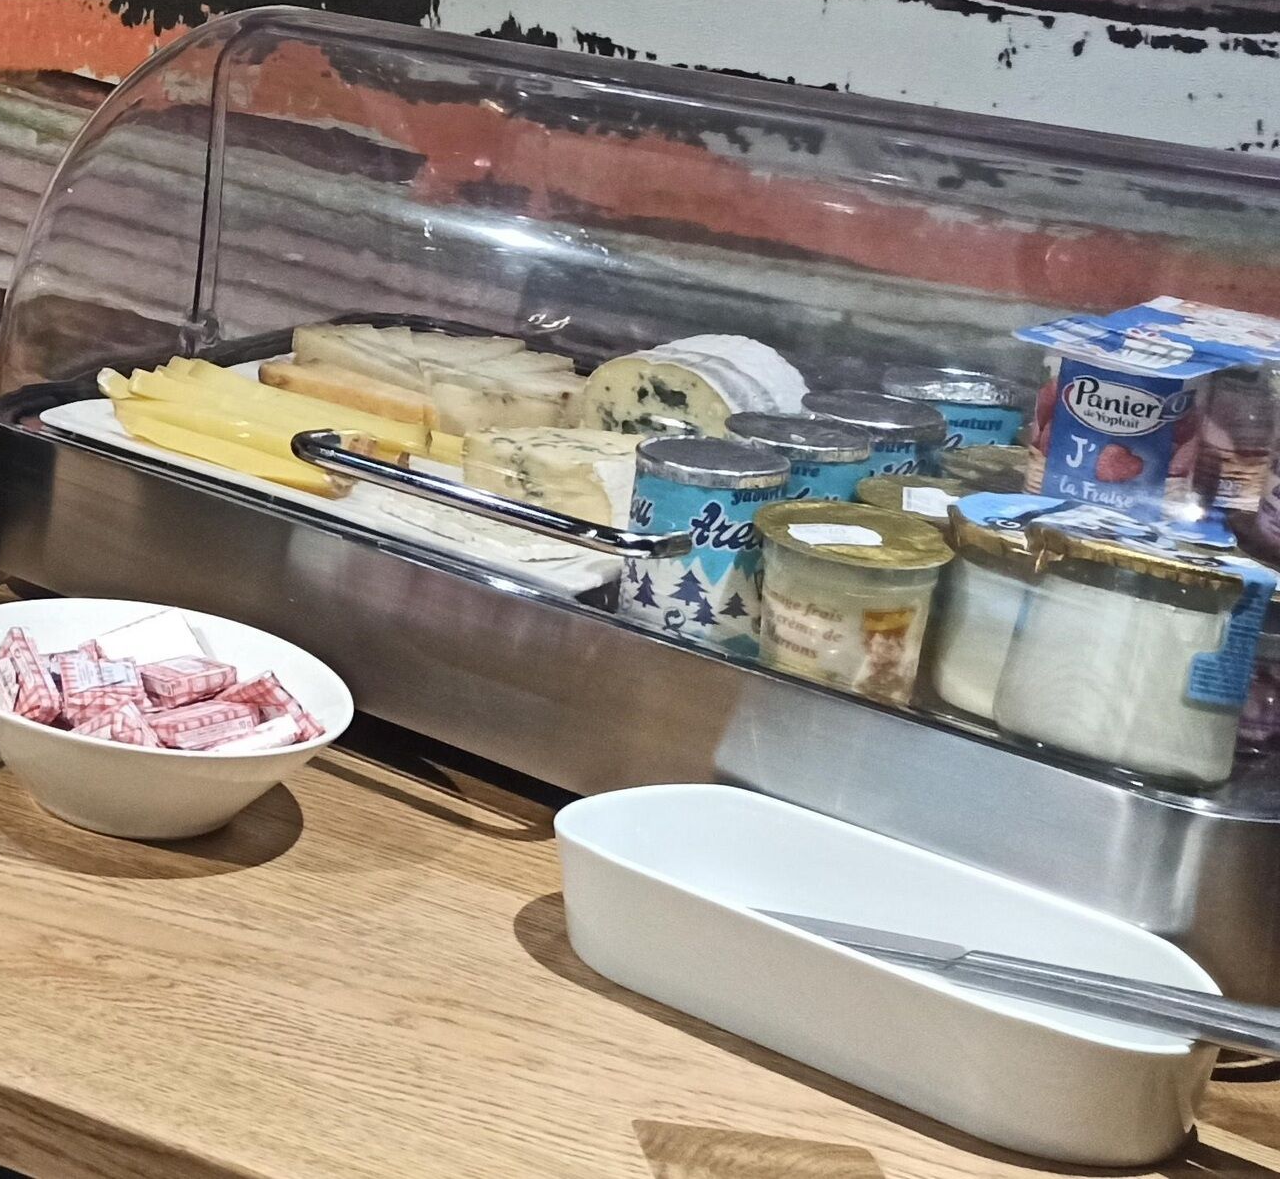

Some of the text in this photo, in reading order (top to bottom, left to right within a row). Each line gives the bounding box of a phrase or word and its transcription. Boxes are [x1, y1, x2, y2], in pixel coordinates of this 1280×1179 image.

[1074, 377, 1160, 419] Panier
[1095, 411, 1140, 429] Yoplait
[1059, 475, 1134, 509] la Fraise
